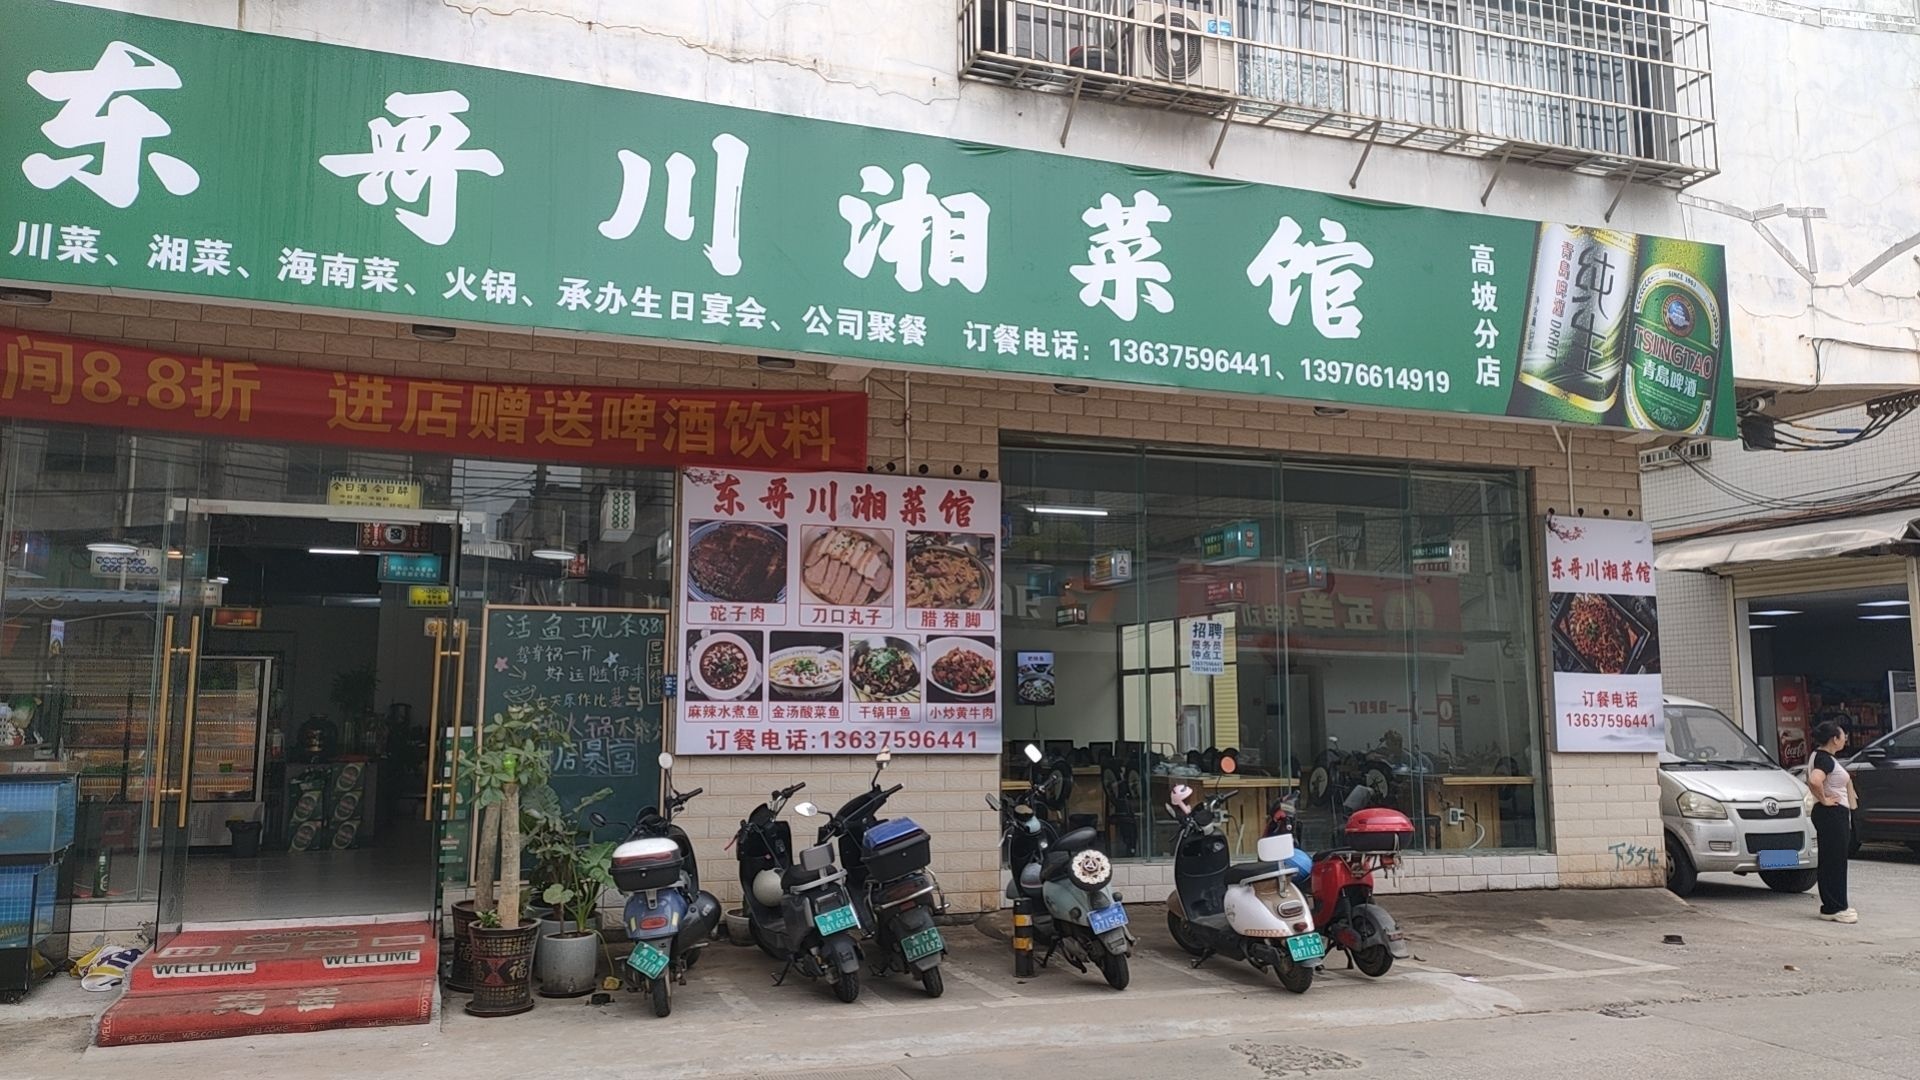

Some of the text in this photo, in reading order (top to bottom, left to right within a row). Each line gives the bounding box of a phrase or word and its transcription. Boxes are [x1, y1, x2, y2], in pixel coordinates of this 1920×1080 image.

[22, 40, 1374, 339] 东哥川湘菜馆
[1469, 243, 1501, 388] 高坡分店
[1545, 318, 1562, 365] DRAFT
[1633, 324, 1714, 381] TSINGTAO
[1641, 360, 1698, 399] 青島啤酒
[1, 335, 836, 463] 间8.8折 进店赠送啤酒饮料
[713, 474, 975, 528] 东哥川湘菜馆
[1551, 556, 1652, 584] 东哥川湘菜馆
[709, 605, 766, 622] 砣子肉
[811, 608, 883, 626] 刀口丸子
[920, 610, 982, 628] 腊猪脚
[1192, 622, 1223, 639] 招聘
[1192, 640, 1222, 651] 服务员
[1192, 650, 1222, 660] 钟点工
[546, 664, 646, 684] 好运随便来
[1582, 691, 1638, 708] 订餐电话
[687, 704, 760, 720] 麻辣水煮鱼
[771, 705, 841, 720] 金汤酸菜鱼
[858, 706, 912, 720] 干锅甲鱼
[928, 706, 995, 720] 小炒黄牛肉
[1566, 712, 1656, 728] 13637596441
